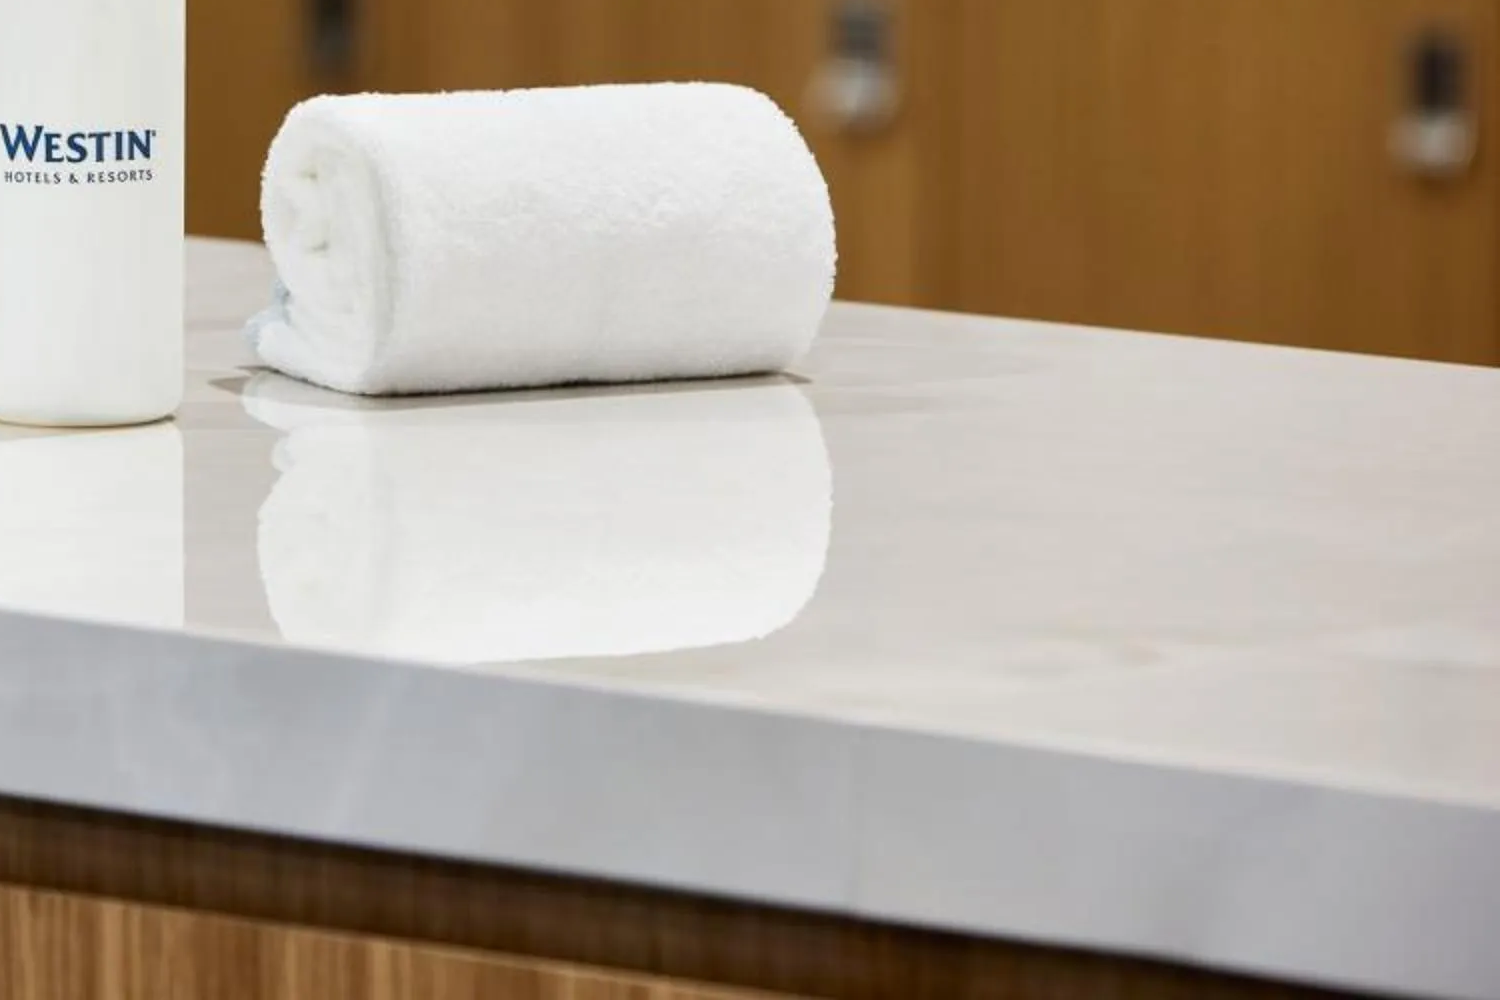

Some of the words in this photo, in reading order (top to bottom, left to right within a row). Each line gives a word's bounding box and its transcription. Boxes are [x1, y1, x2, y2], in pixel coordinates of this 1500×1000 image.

[4, 171, 62, 184] HOTELS
[68, 172, 79, 184] &
[87, 169, 153, 184] RESORTS
